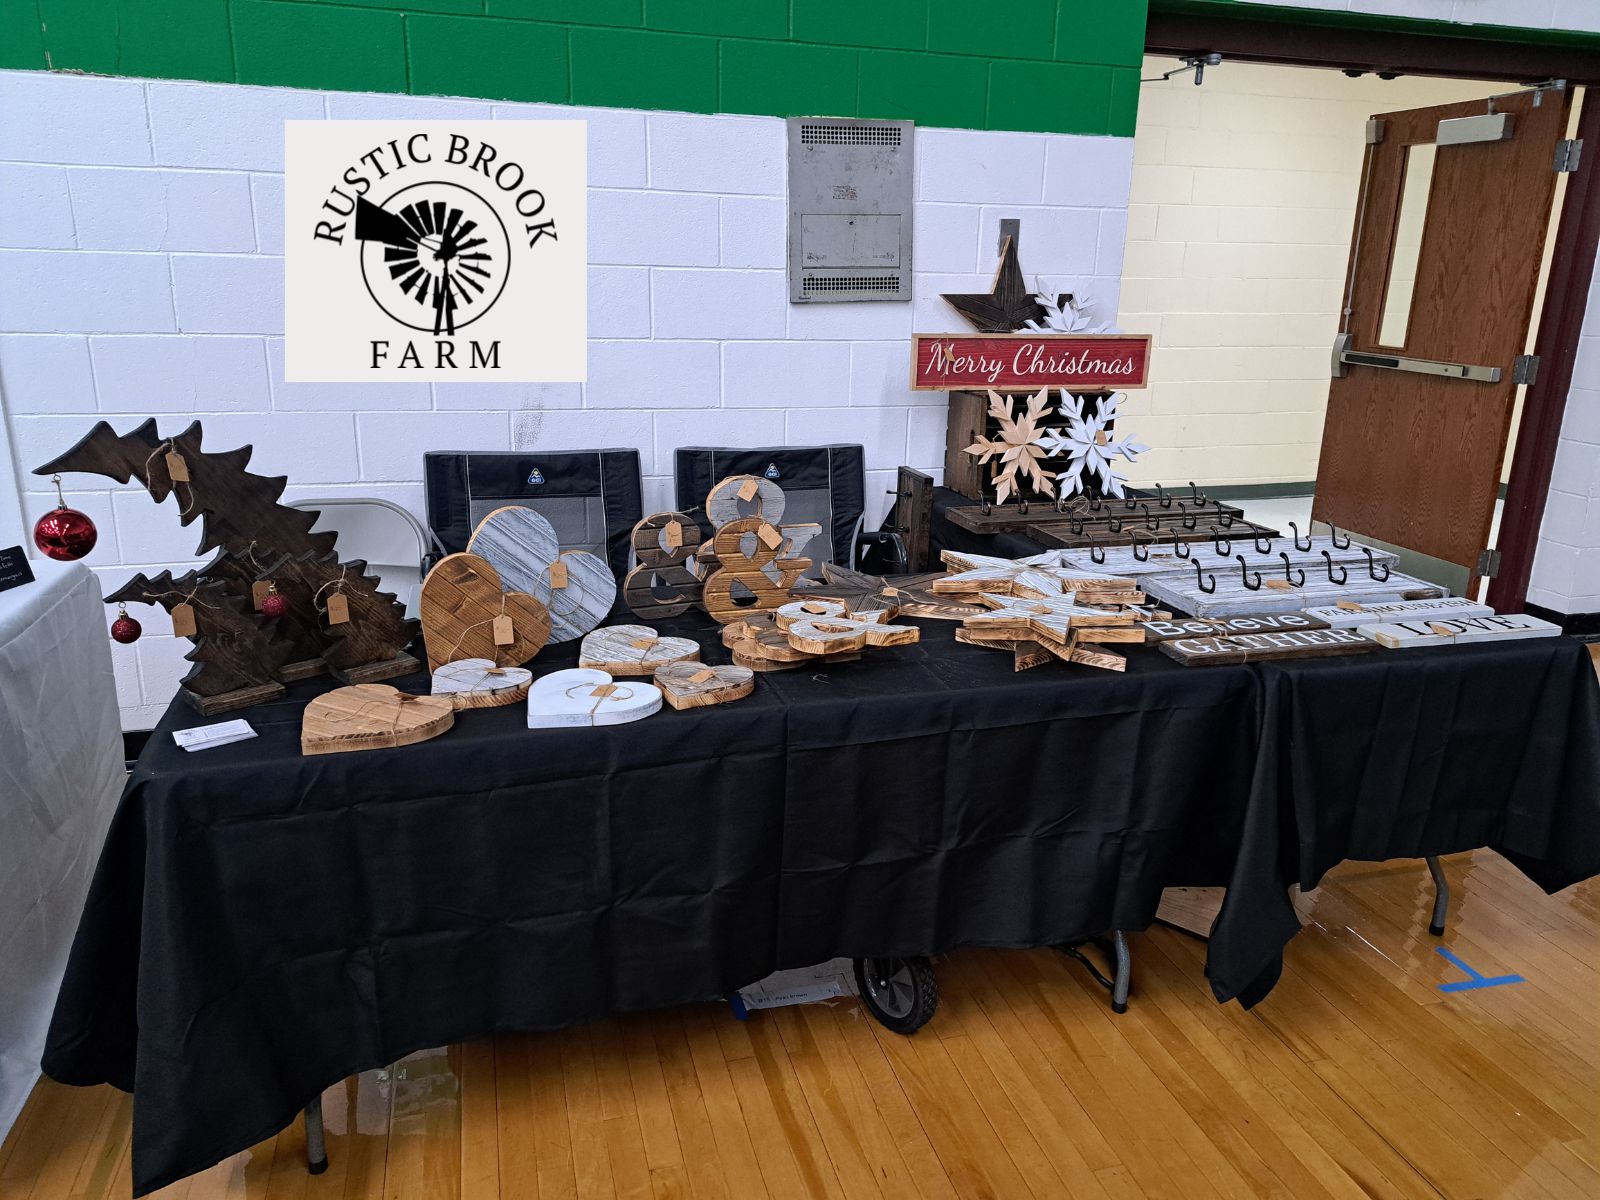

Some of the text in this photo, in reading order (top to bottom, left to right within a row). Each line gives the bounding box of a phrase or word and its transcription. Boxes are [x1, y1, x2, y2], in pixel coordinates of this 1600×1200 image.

[925, 342, 1136, 383] Merry Christmas
[1389, 616, 1532, 636] LOVE
[1173, 628, 1367, 654] GATHER
